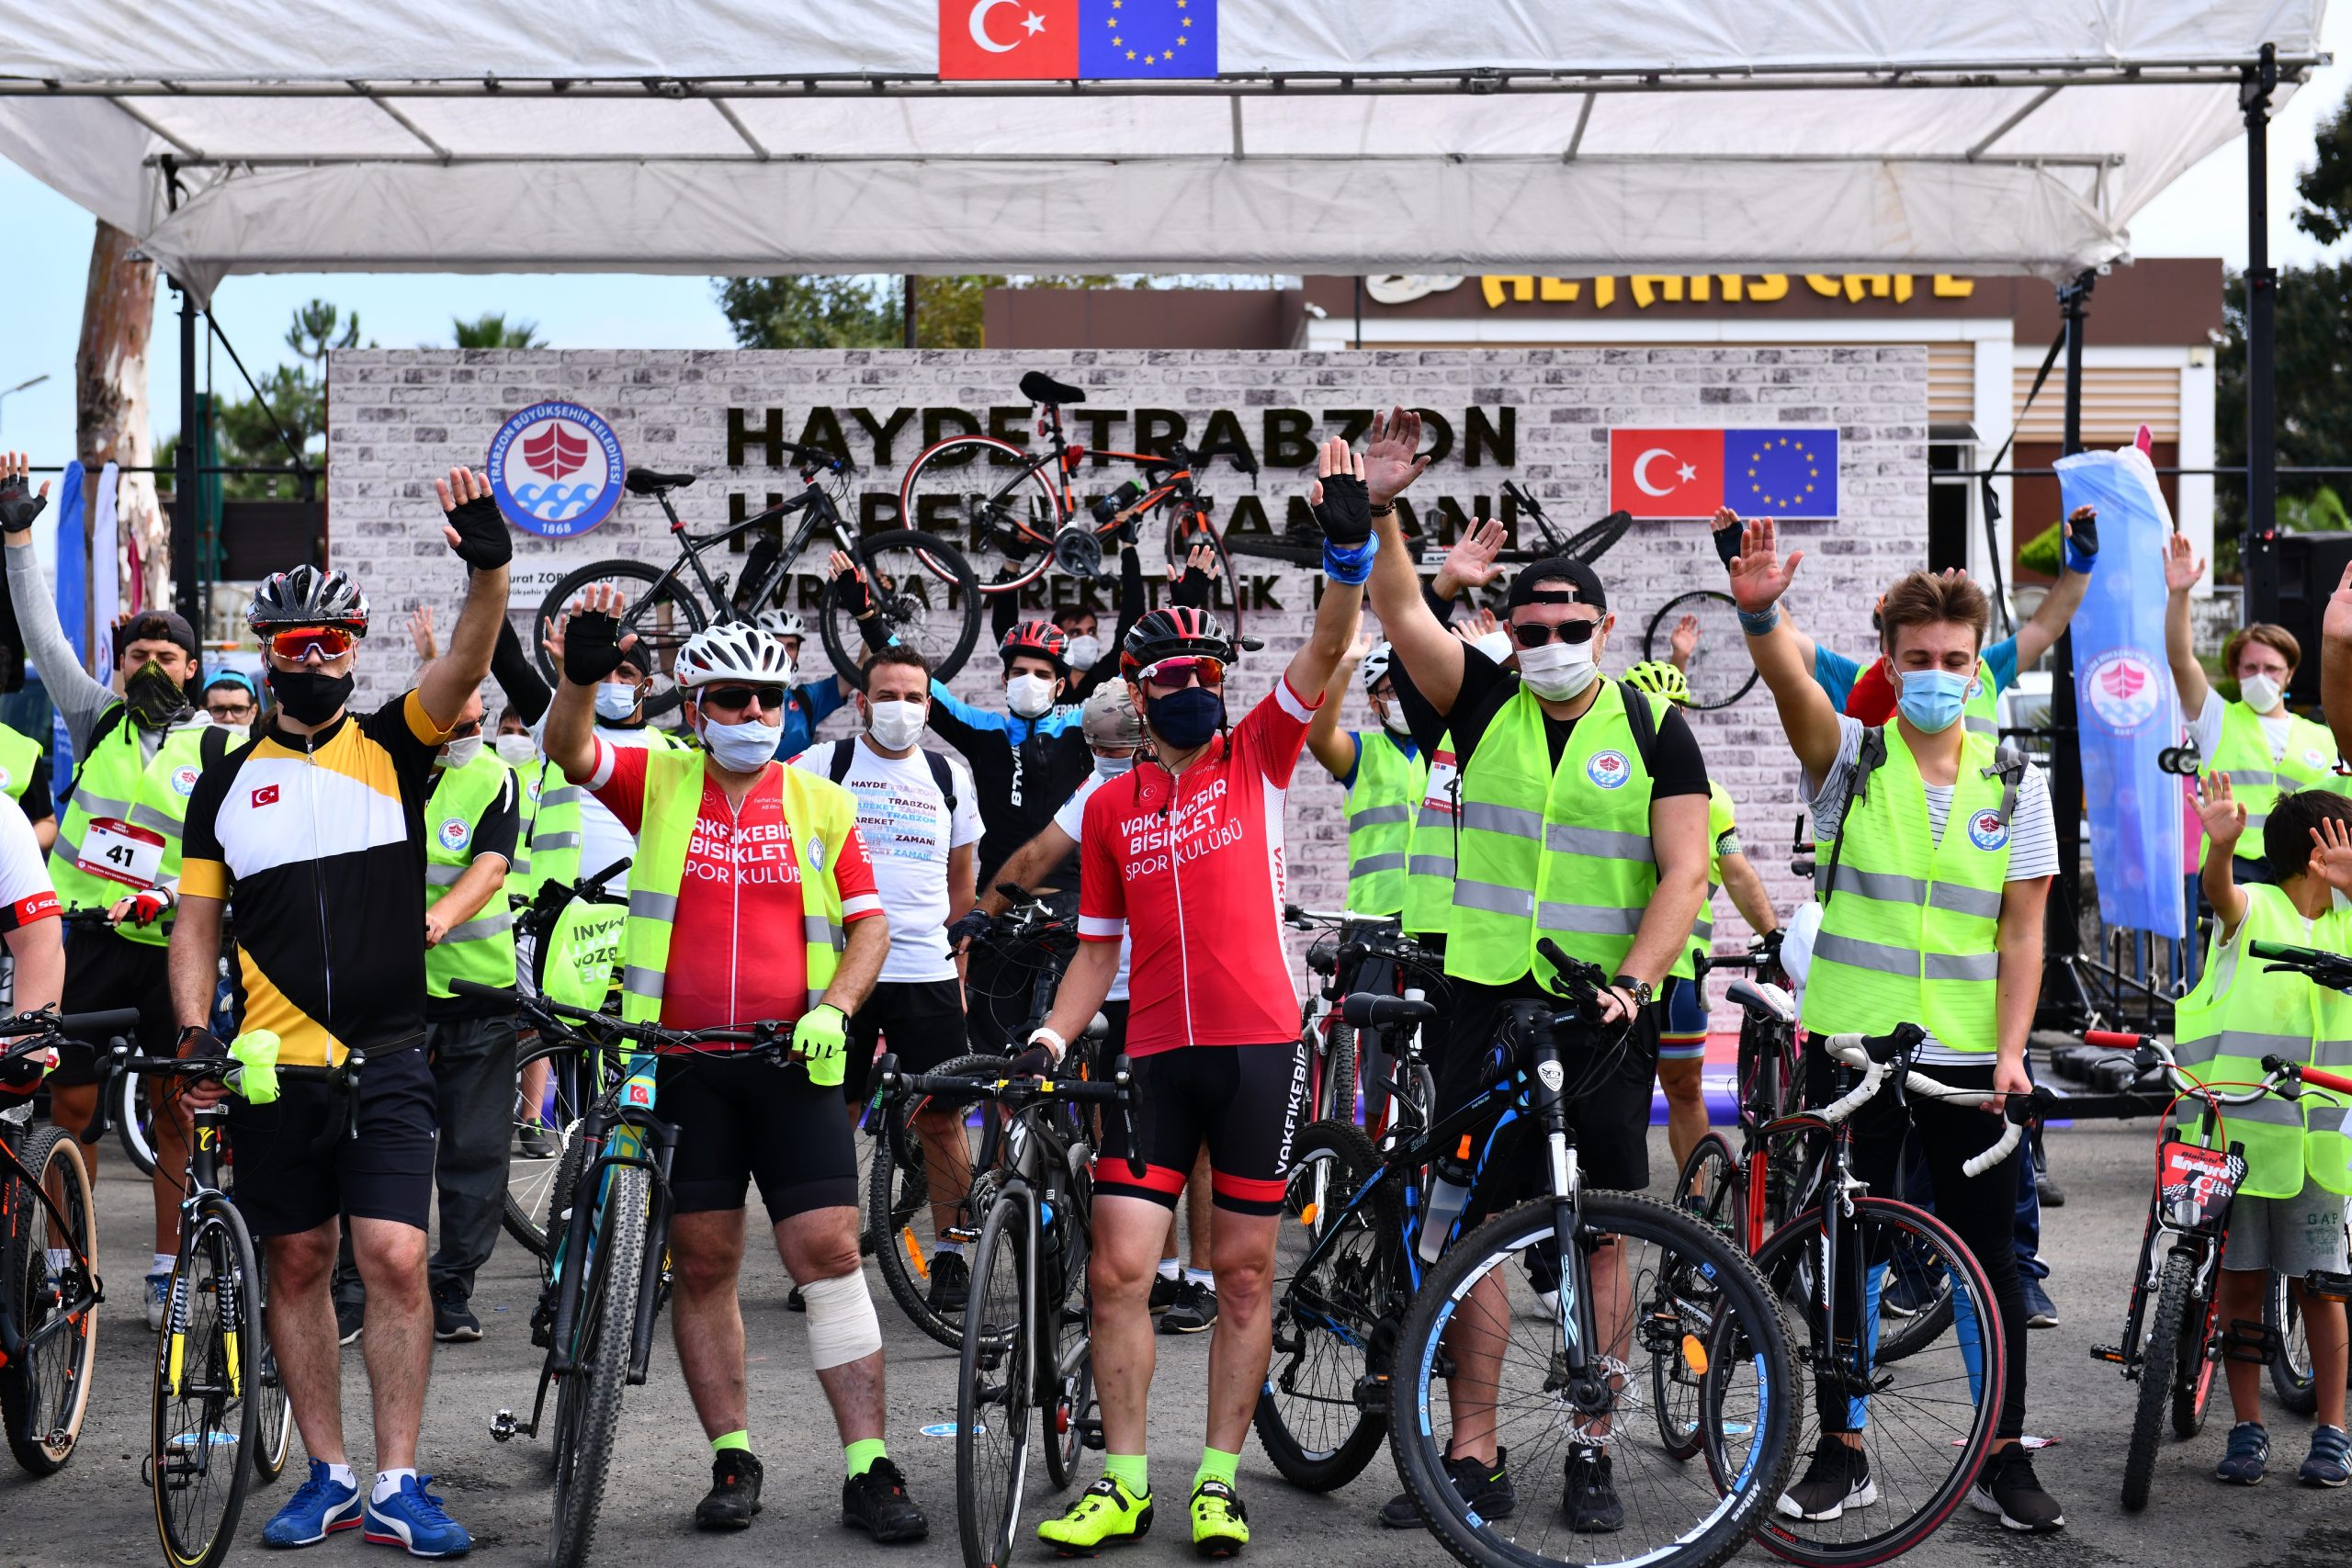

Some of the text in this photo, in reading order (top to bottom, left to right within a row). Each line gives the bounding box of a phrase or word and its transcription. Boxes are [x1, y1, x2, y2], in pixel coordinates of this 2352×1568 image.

[491, 405, 621, 485] TRABZON BÜYÜKŞEHİR BELEDİYESİ
[727, 406, 1516, 468] HAYDE TRABZON
[542, 523, 571, 534] 1868
[729, 493, 1137, 555] HAREK
[509, 573, 533, 583] urat
[851, 781, 888, 789] HAYDE
[857, 802, 896, 811] AREKET
[888, 797, 937, 811] TRABZON
[854, 817, 895, 826] AREKET
[886, 811, 936, 824] TRABZON
[1129, 805, 1217, 856] BİSİKLET
[106, 845, 134, 867] 41
[689, 835, 788, 864] BİSİKLET
[1125, 818, 1243, 882] SPOR KULÜBÜ
[684, 859, 729, 884] POR
[573, 917, 626, 942] MANI
[1555, 1014, 1575, 1023] DACRON
[2170, 1154, 2231, 1179] Enduro
[2180, 1150, 2219, 1165] Bianchi
[2307, 1213, 2339, 1225] GAP
[1731, 1478, 1762, 1523] Mitas
